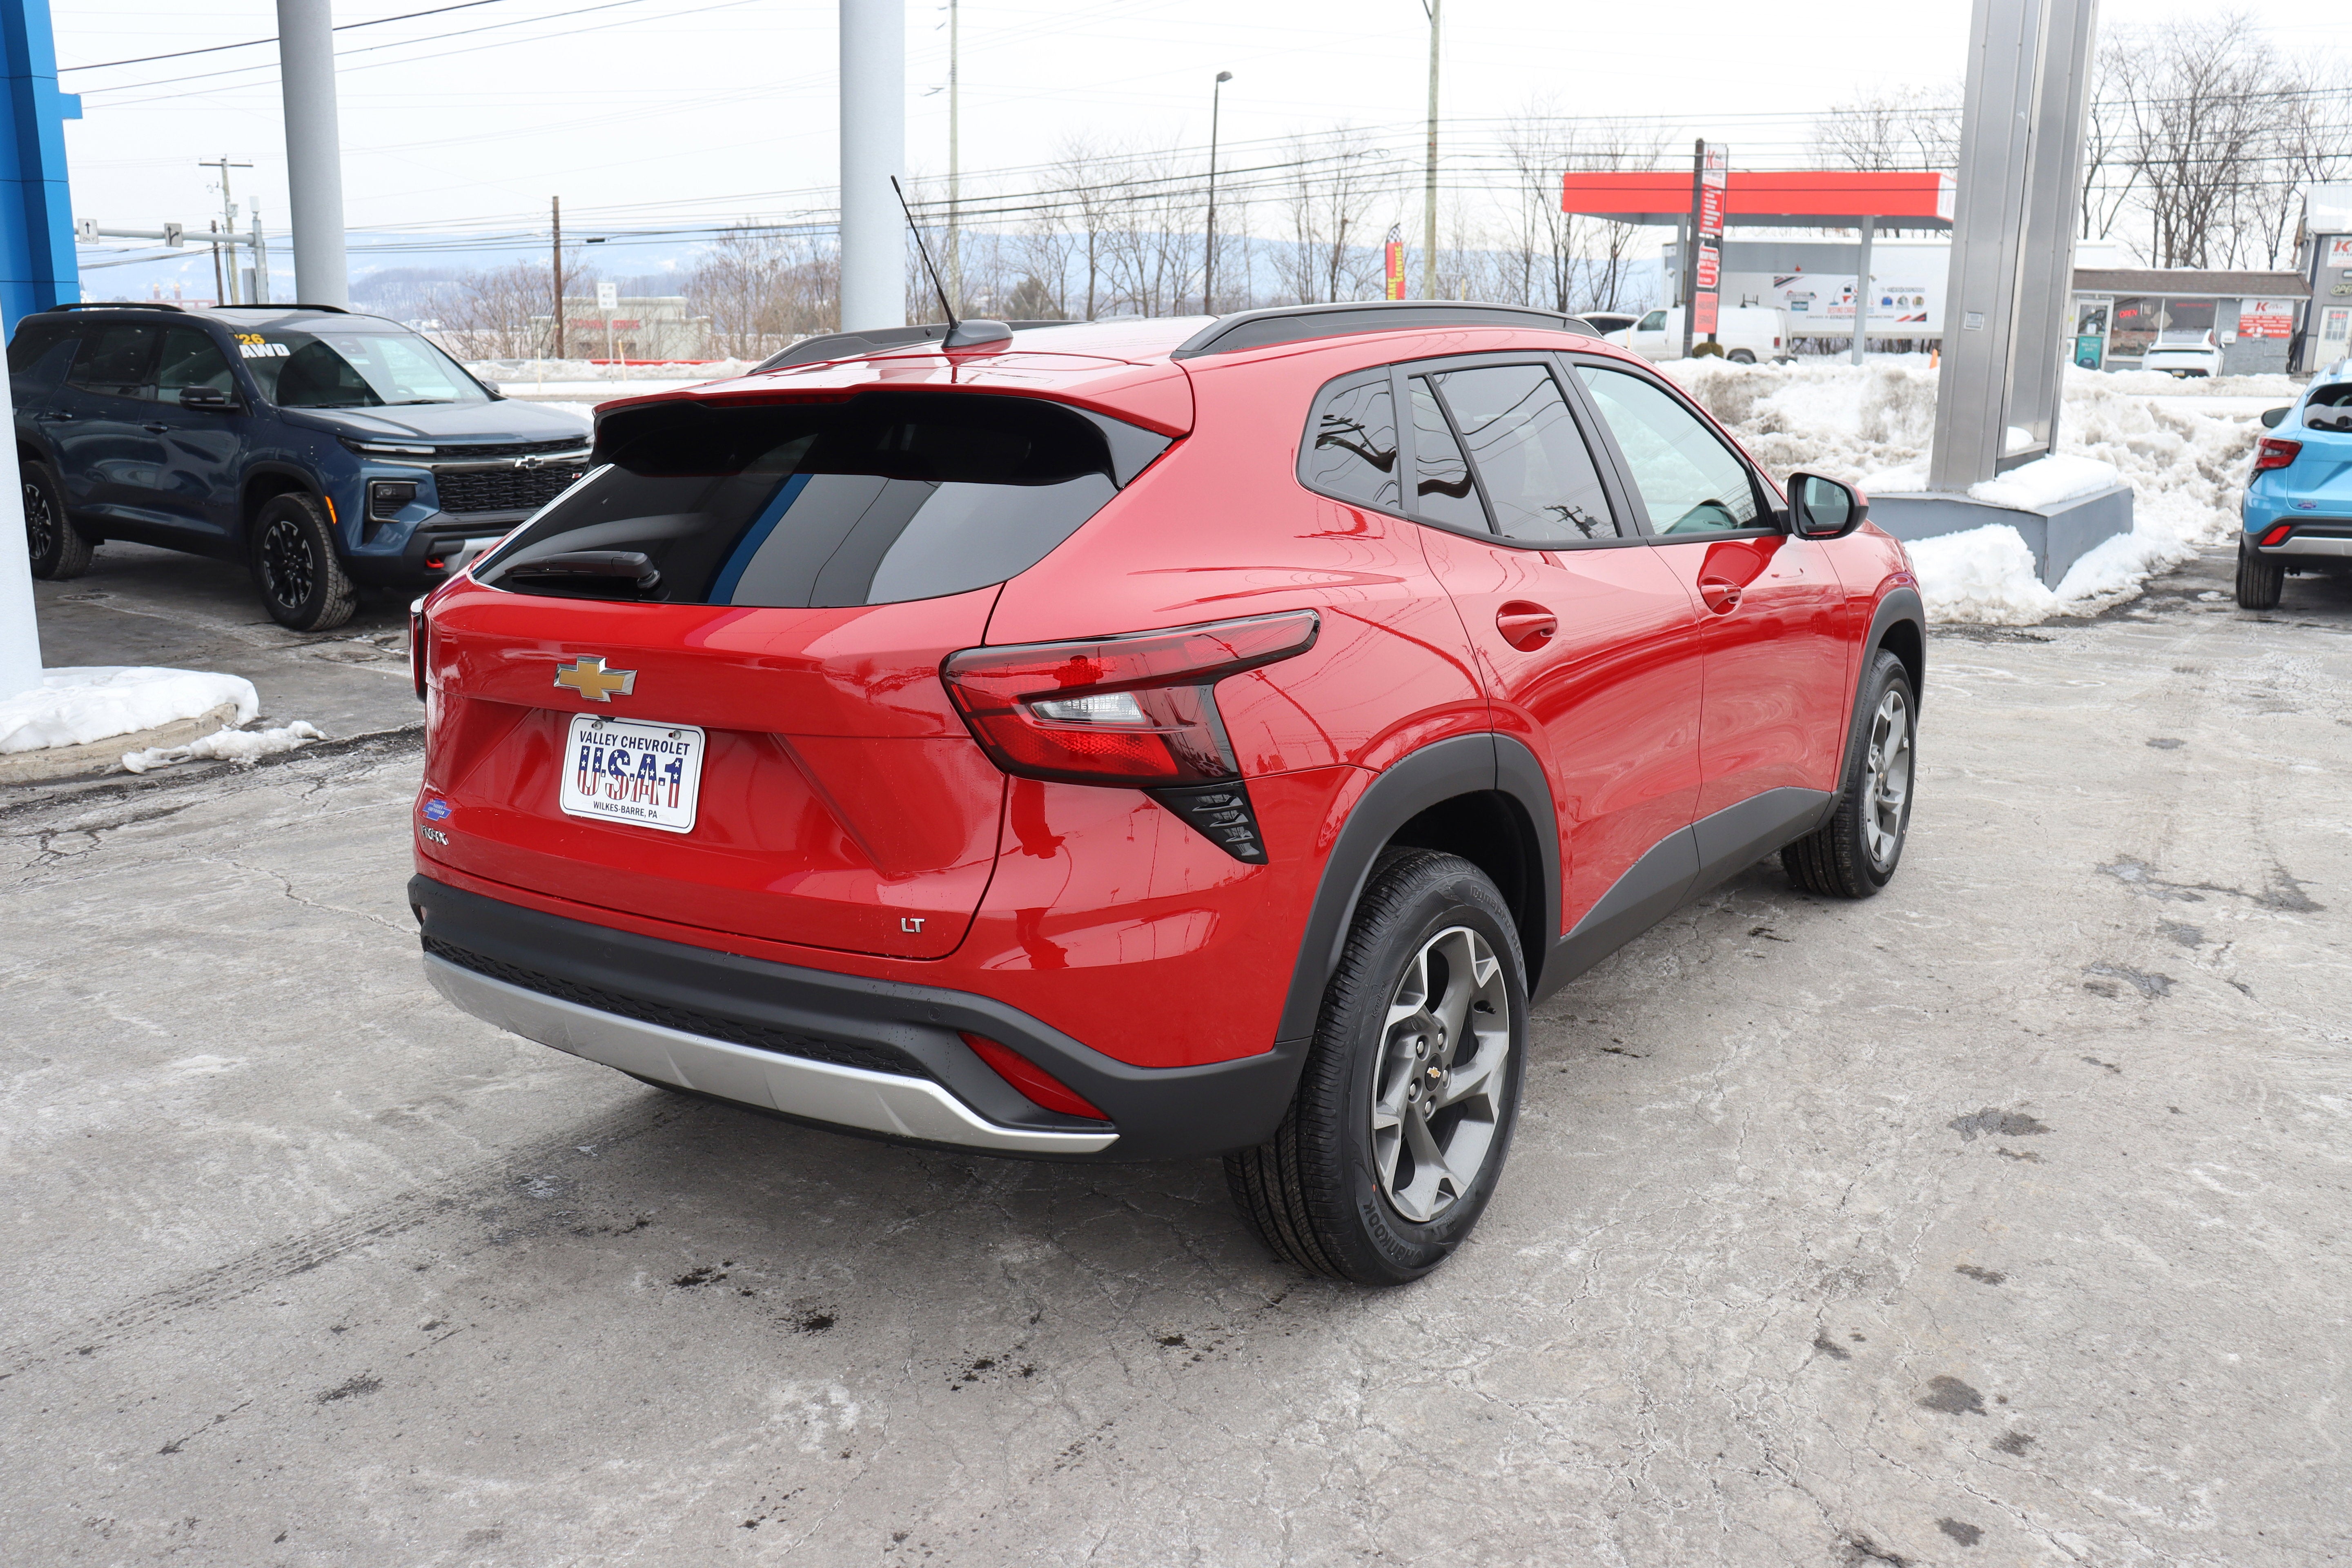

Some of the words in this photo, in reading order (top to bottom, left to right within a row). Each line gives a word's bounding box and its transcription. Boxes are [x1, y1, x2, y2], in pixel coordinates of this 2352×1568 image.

[1394, 245, 1403, 282] SERVICE
[1388, 277, 1396, 300] RAKE
[2119, 309, 2138, 318] OPEN
[234, 333, 265, 345] '26
[239, 343, 290, 358] AWD
[580, 731, 619, 746] VALLEY
[621, 736, 690, 755] CHEVROLET
[593, 801, 646, 819] WILKES-BARRE,
[648, 810, 658, 819] PA
[420, 824, 449, 846] TRAX
[901, 918, 925, 933] LT
[1371, 980, 1387, 1018] Kontrol
